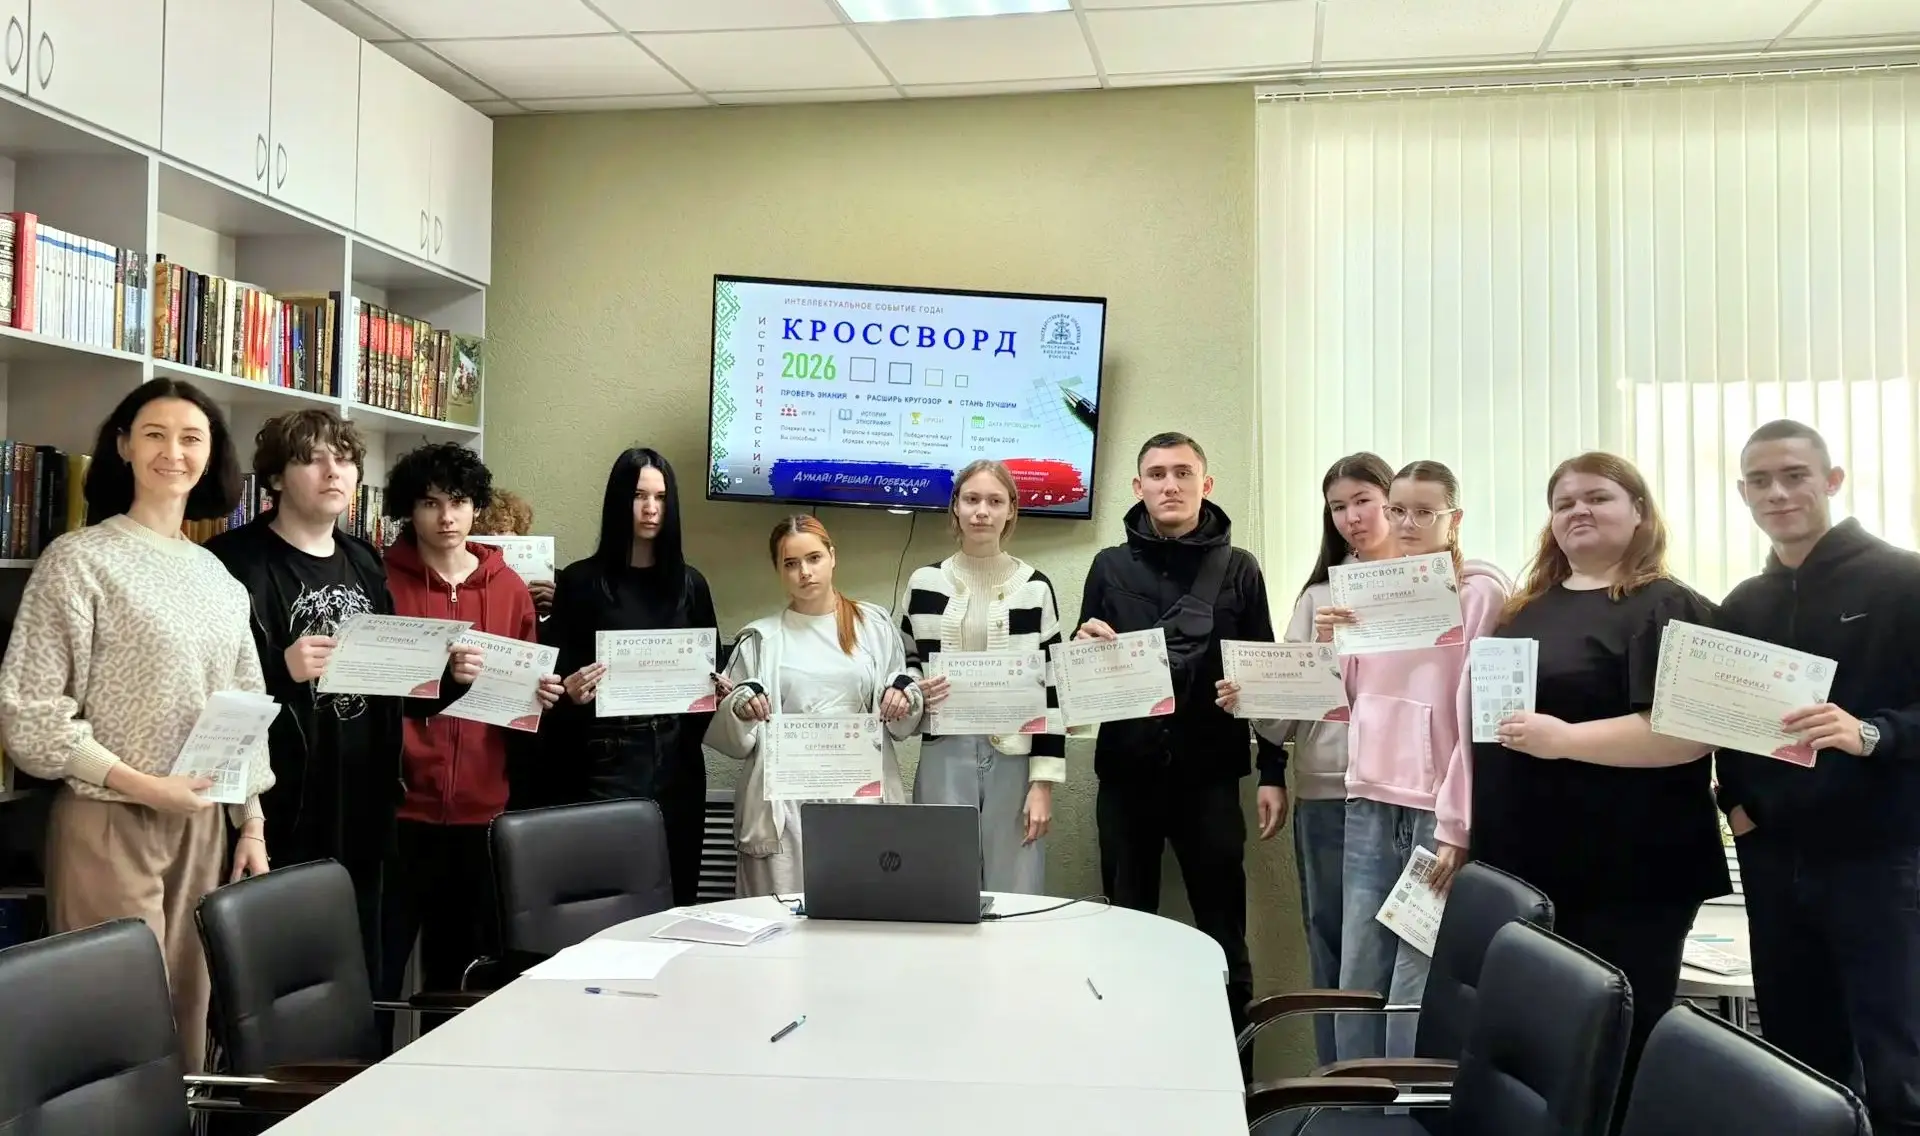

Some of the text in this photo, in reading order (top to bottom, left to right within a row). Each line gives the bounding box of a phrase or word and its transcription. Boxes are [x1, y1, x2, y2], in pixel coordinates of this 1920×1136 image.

[784, 298, 944, 315] ИНТЕЛЛЕКТУАЛЬНОЕ СОБЫТИЕ ГОДА!
[782, 318, 1017, 358] КРОССВОРД
[782, 352, 836, 380] 2026
[752, 317, 766, 474] ИСТОРИЧЕСКИЙ
[780, 389, 1017, 409] ПРОВЕРЬ ЗНАНИЯ РАСШИРЬ КРУГОЗОР СТАНЬ ЛУЧШИМ
[1347, 567, 1405, 580] КРОССВОРД
[457, 637, 512, 655] РОССВОРД
[616, 638, 673, 646] КРОССВОРД
[1069, 642, 1124, 656] КРОССВОРД
[1692, 636, 1769, 664] КРОССВОРД
[1238, 650, 1292, 658] КРОССВОРД
[1714, 671, 1772, 691] СЕРТИФИКАТ
[783, 722, 839, 730] КРОССВОРД
